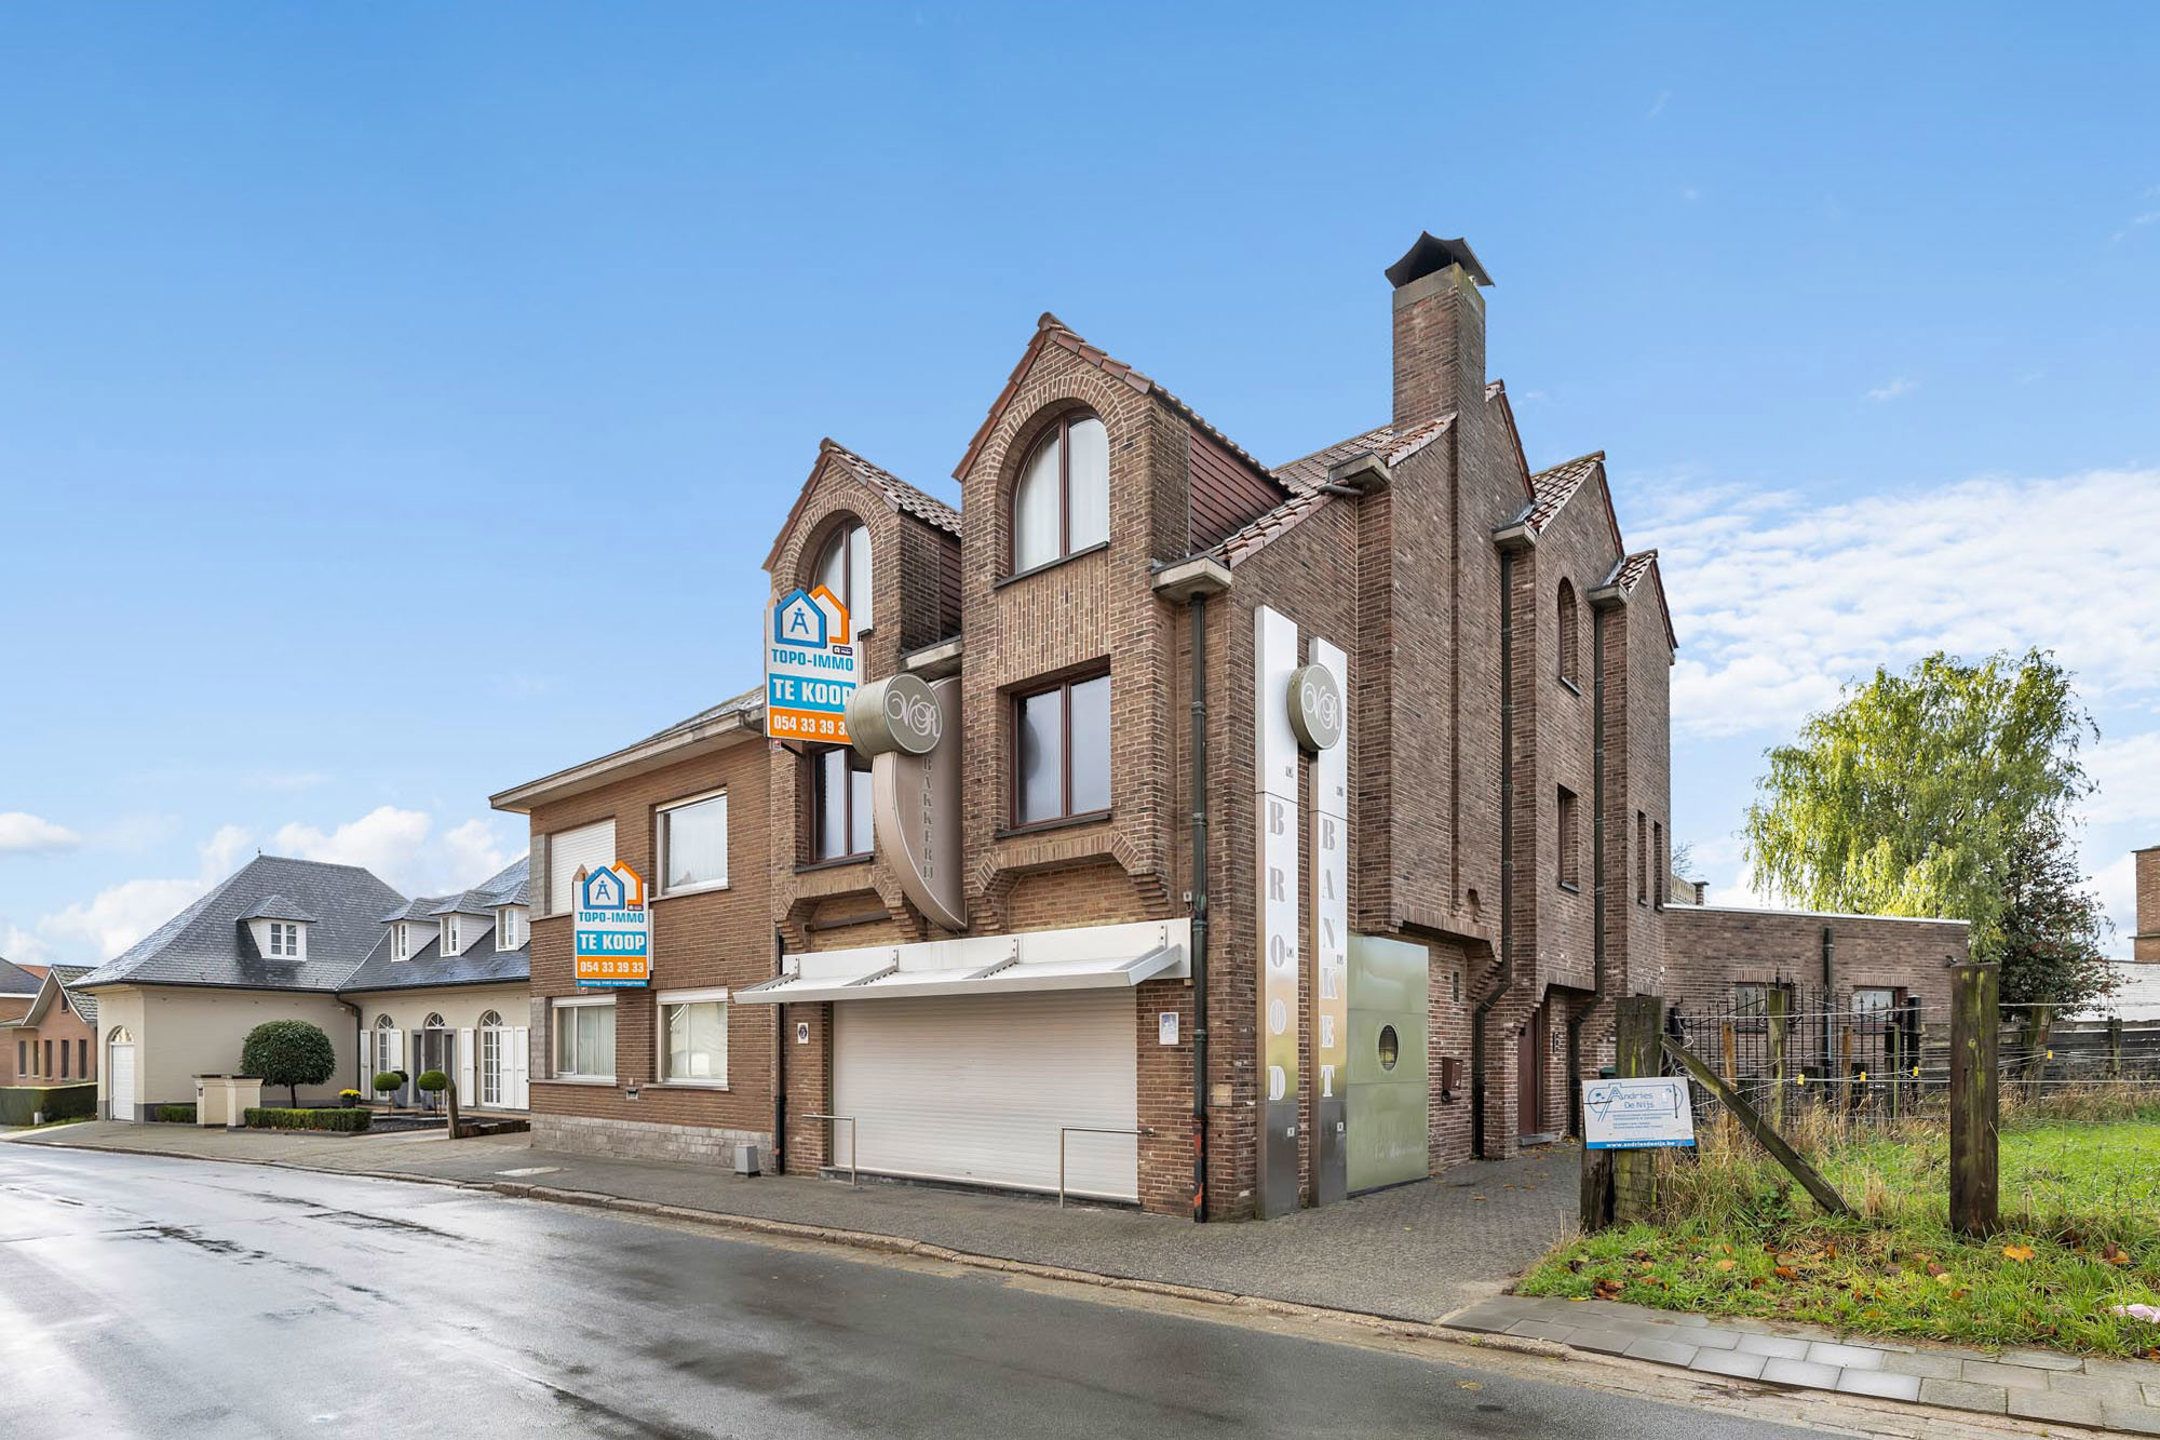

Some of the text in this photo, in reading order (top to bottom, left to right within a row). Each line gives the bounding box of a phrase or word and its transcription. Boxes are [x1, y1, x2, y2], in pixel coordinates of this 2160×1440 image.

[772, 648, 853, 671] TOPO-IMMO
[773, 679, 795, 700] TE
[773, 715, 848, 736] 054 33 39 3
[578, 911, 645, 923] TOPO-IMMO
[579, 933, 645, 951] TE KOOP
[1268, 799, 1286, 1101] BROOD
[580, 961, 644, 973] 054 33 39 33
[1320, 818, 1337, 1098] BANKET
